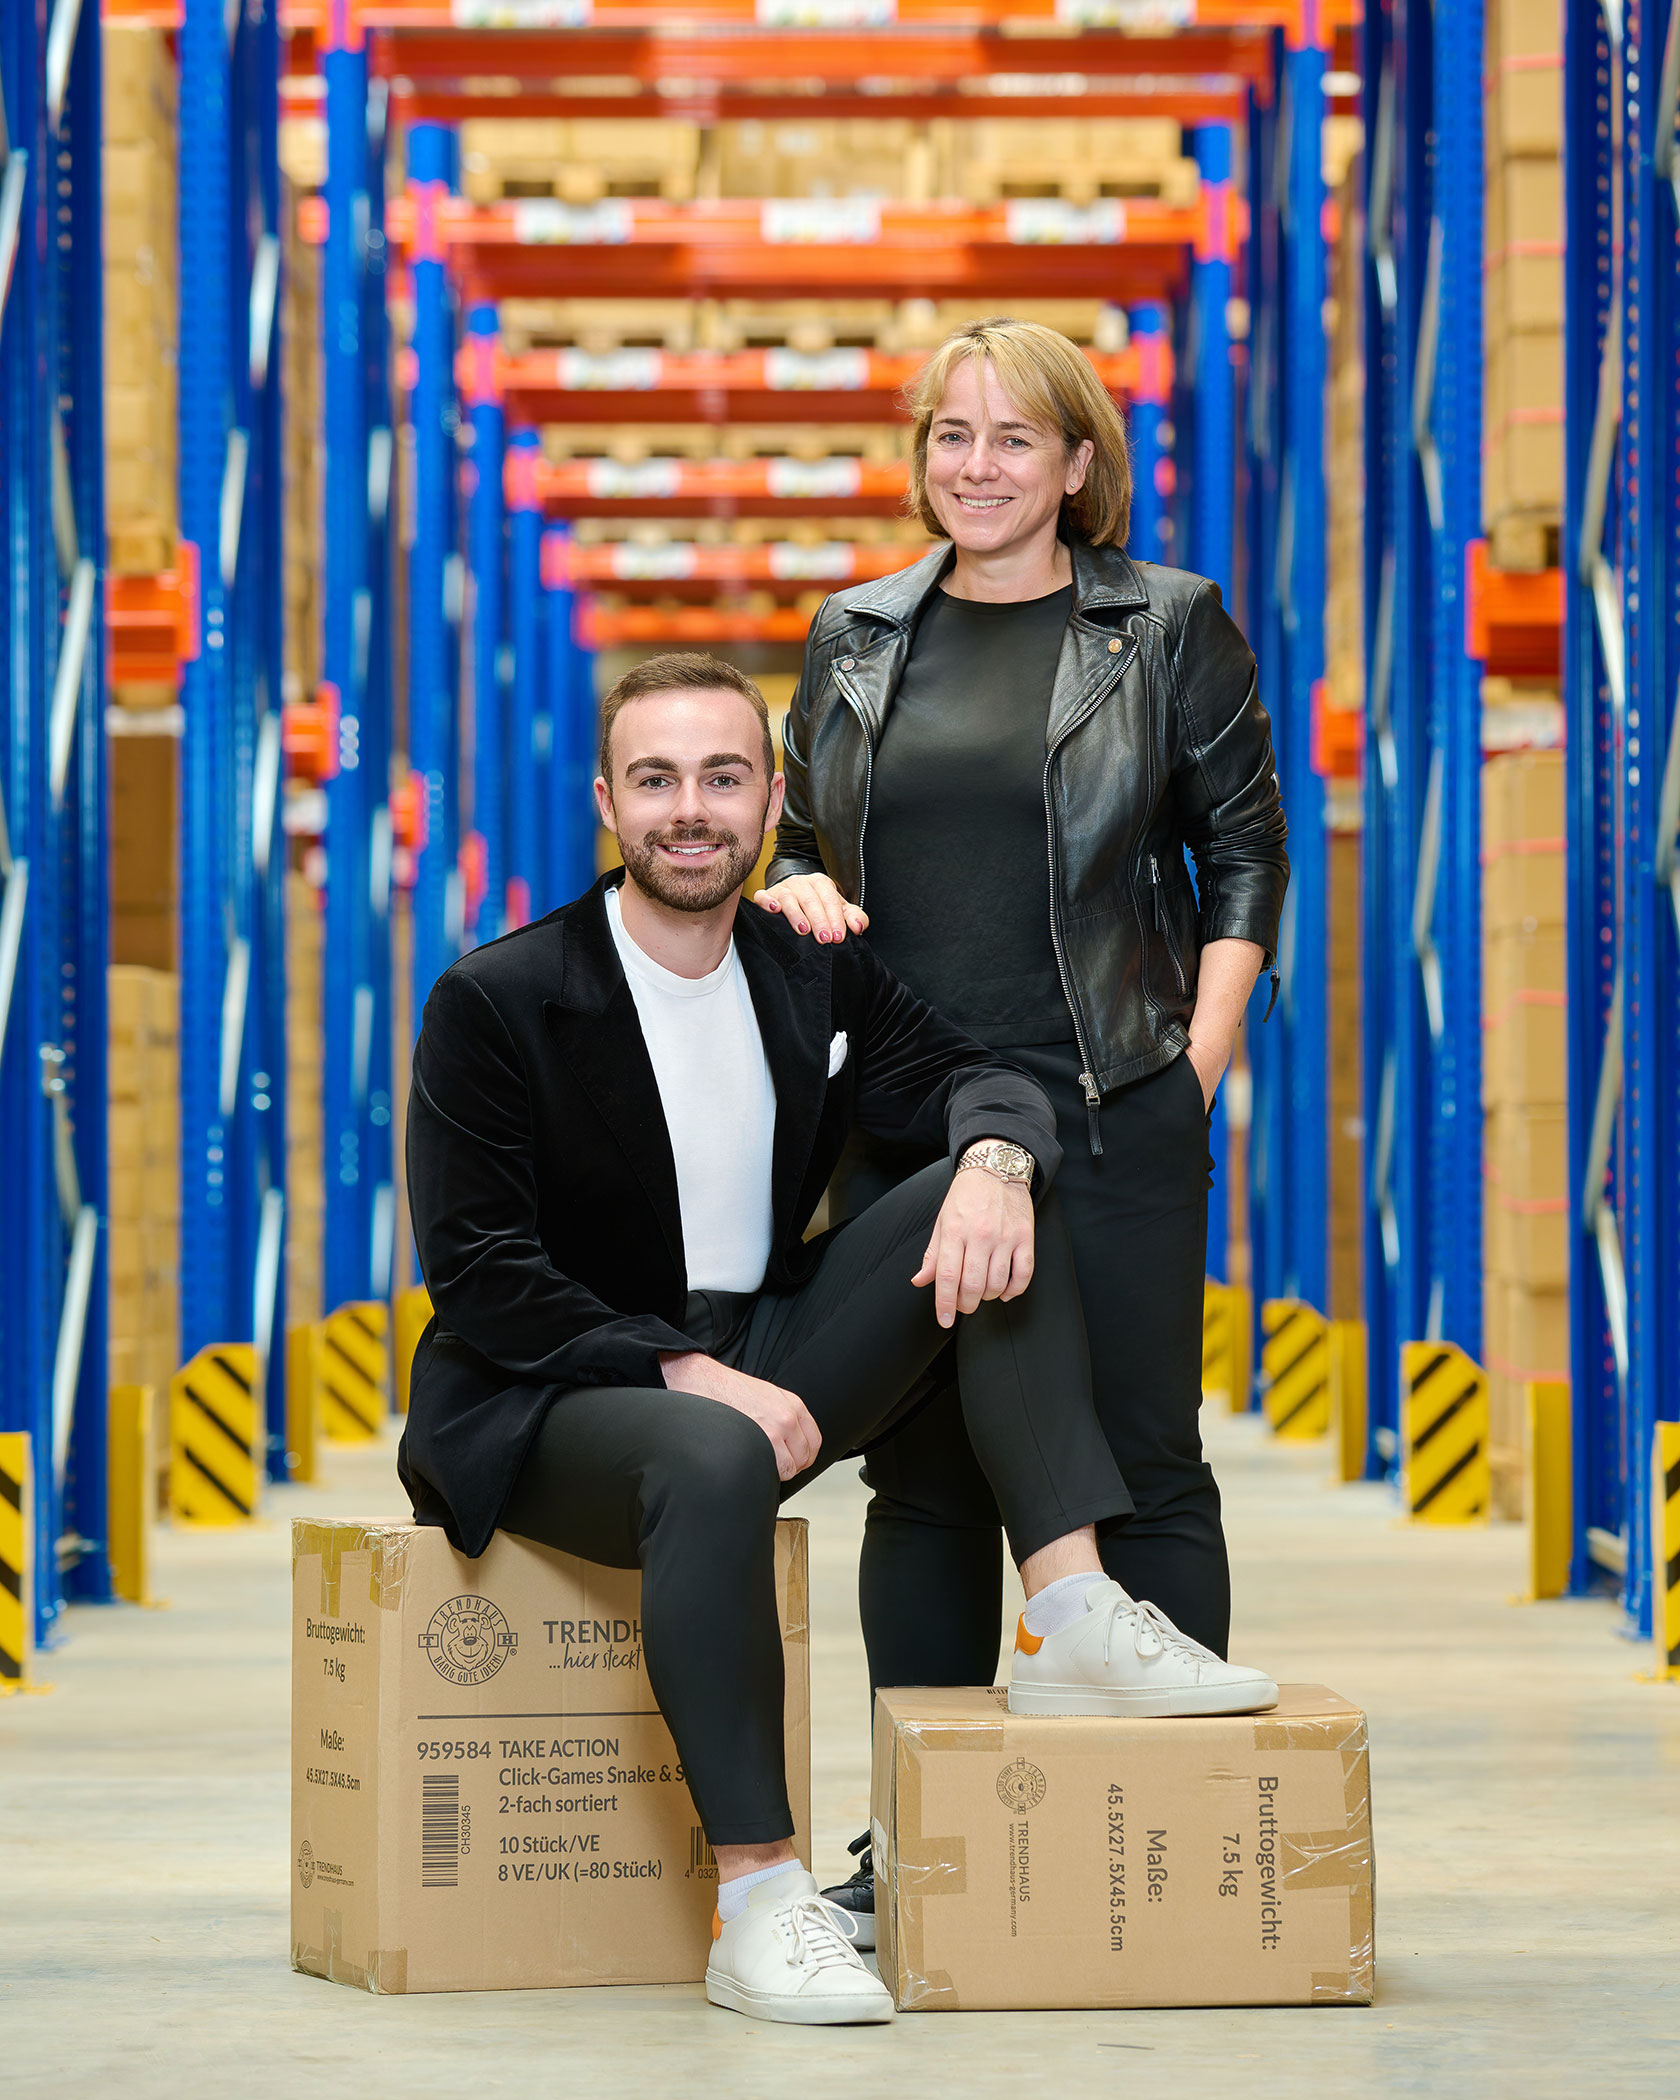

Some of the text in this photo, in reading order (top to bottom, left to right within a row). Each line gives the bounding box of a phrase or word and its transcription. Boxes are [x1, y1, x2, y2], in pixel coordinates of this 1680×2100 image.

[433, 1598, 503, 1627] TRENDHAUS
[306, 1618, 366, 1645] Bruttogewicht:
[423, 1636, 434, 1646] T
[502, 1635, 513, 1645] H
[543, 1620, 642, 1644] TRENDH
[602, 1643, 642, 1671] steckt
[323, 1657, 346, 1683] 7.5 kg
[457, 1670, 479, 1683] GUTE
[320, 1728, 345, 1751] Maße:
[417, 1741, 492, 1760] 959584
[499, 1738, 619, 1759] TAKE ACTION
[306, 1767, 361, 1791] 45.5X27.5X45.5cm
[499, 1764, 685, 1786] Click-Games Snake & S
[499, 1794, 618, 1814] 2-fach sortiert
[461, 1805, 471, 1855] CH30345
[500, 1835, 600, 1854] 10 Stück/VE
[498, 1859, 663, 1882] 8 VE/UK (=80 Stück)
[1018, 1821, 1030, 1903] TRENDHAUS
[1108, 1783, 1126, 1952] 45.5X27.5X45.5cm
[1147, 1830, 1168, 1902] Maße:
[1219, 1833, 1243, 1897] 7.5 kg
[1256, 1776, 1282, 1950] Bruttogewicht:
[685, 1870, 690, 1879] 4
[1009, 1823, 1017, 1937] www.trendhaus-germany.com
